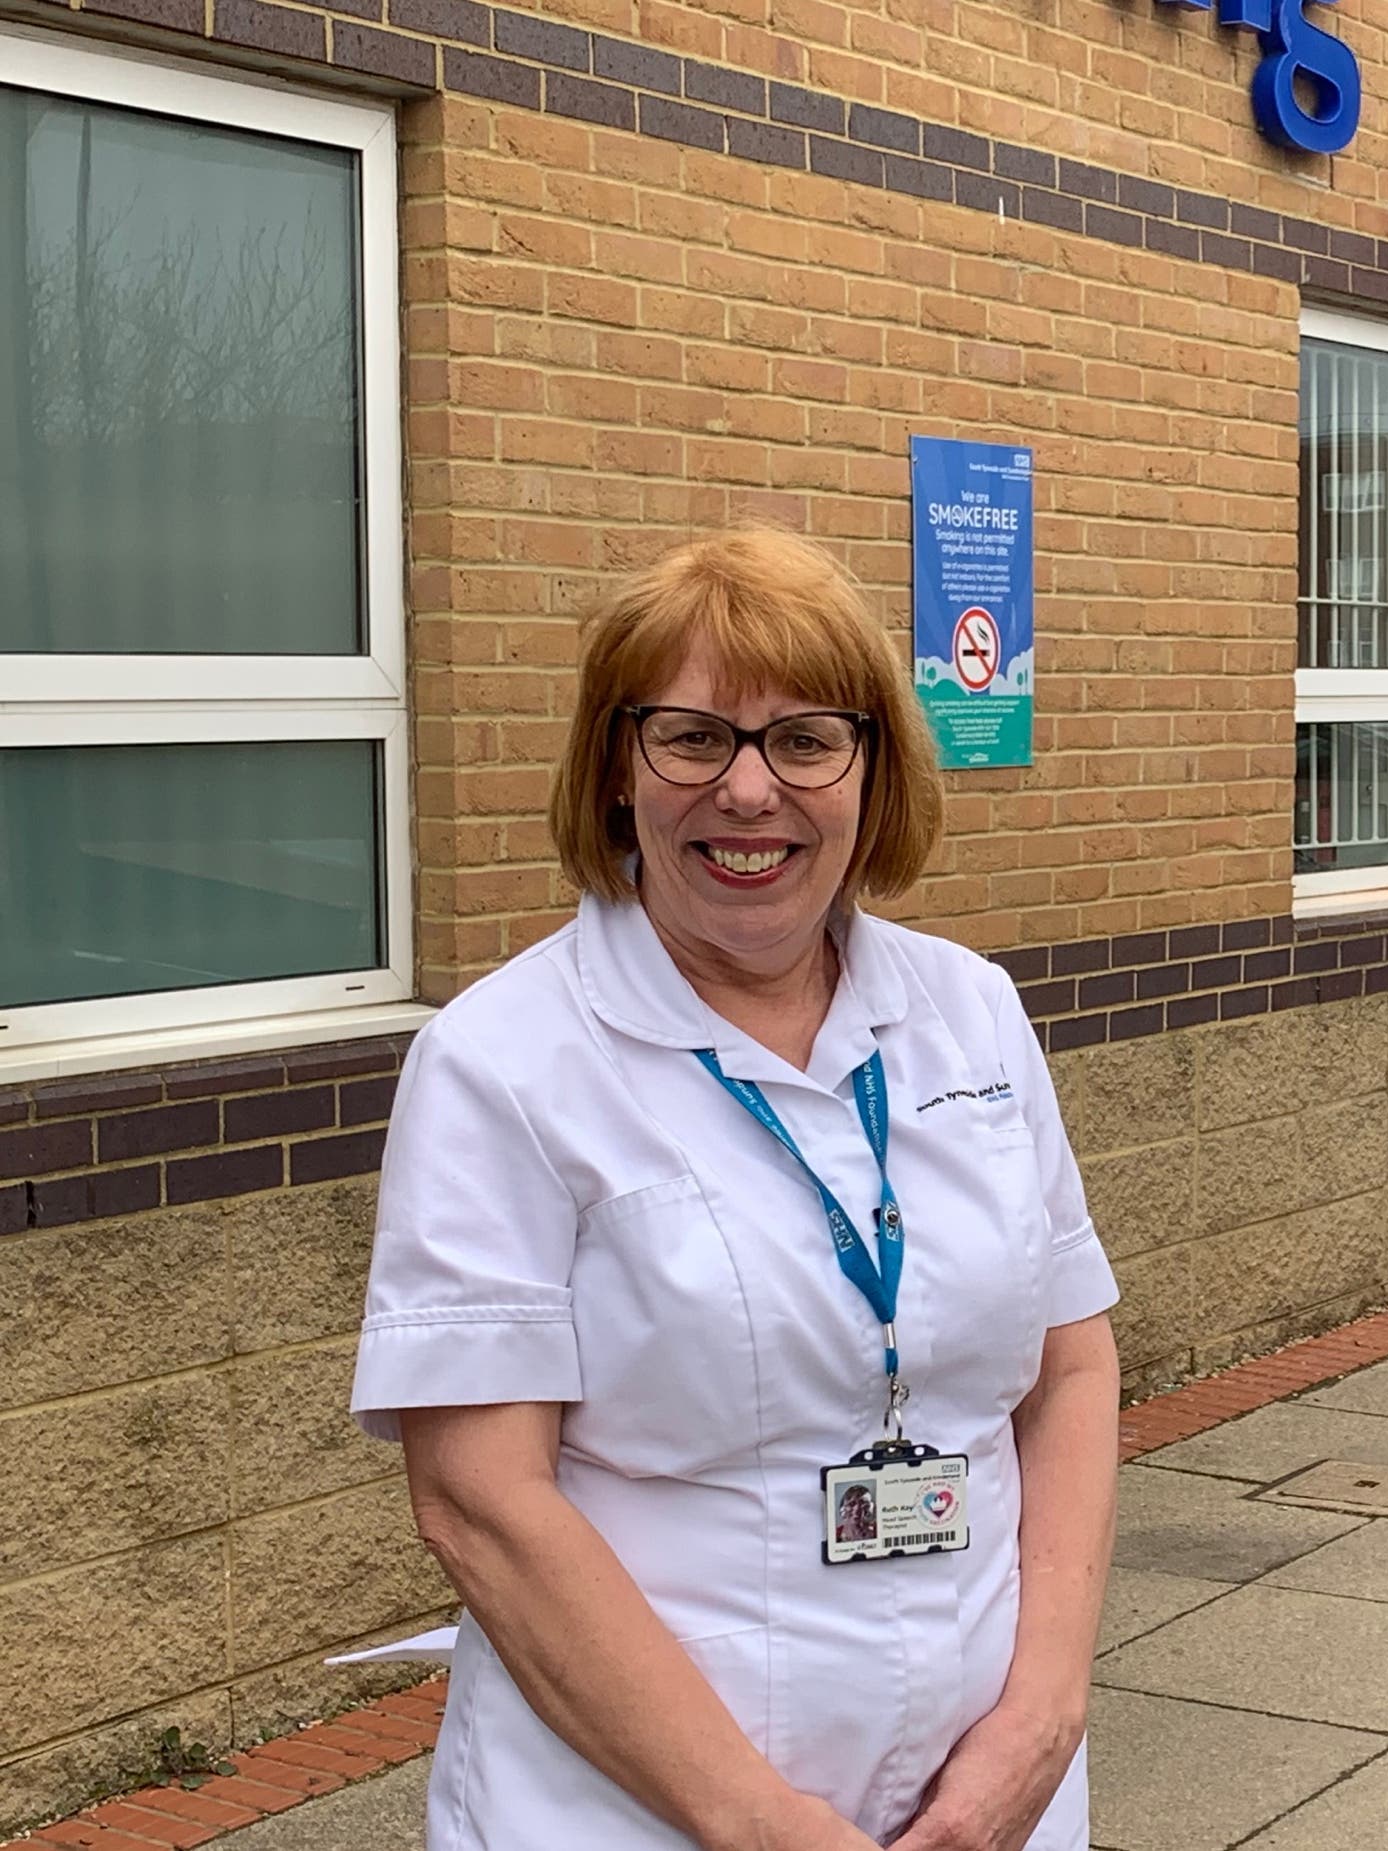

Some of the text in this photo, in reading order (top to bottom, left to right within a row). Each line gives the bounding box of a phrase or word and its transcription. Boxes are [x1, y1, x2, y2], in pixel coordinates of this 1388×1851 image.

[961, 490, 990, 504] We are
[928, 503, 1019, 531] SMOKEFREE
[935, 529, 1015, 545] Smoking is not permitted
[941, 543, 974, 556] anywhere
[975, 546, 984, 555] on
[864, 1074, 876, 1095] NHS
[978, 1085, 994, 1098] and
[829, 1210, 854, 1251] NHS
[882, 1505, 899, 1513] Ruth
